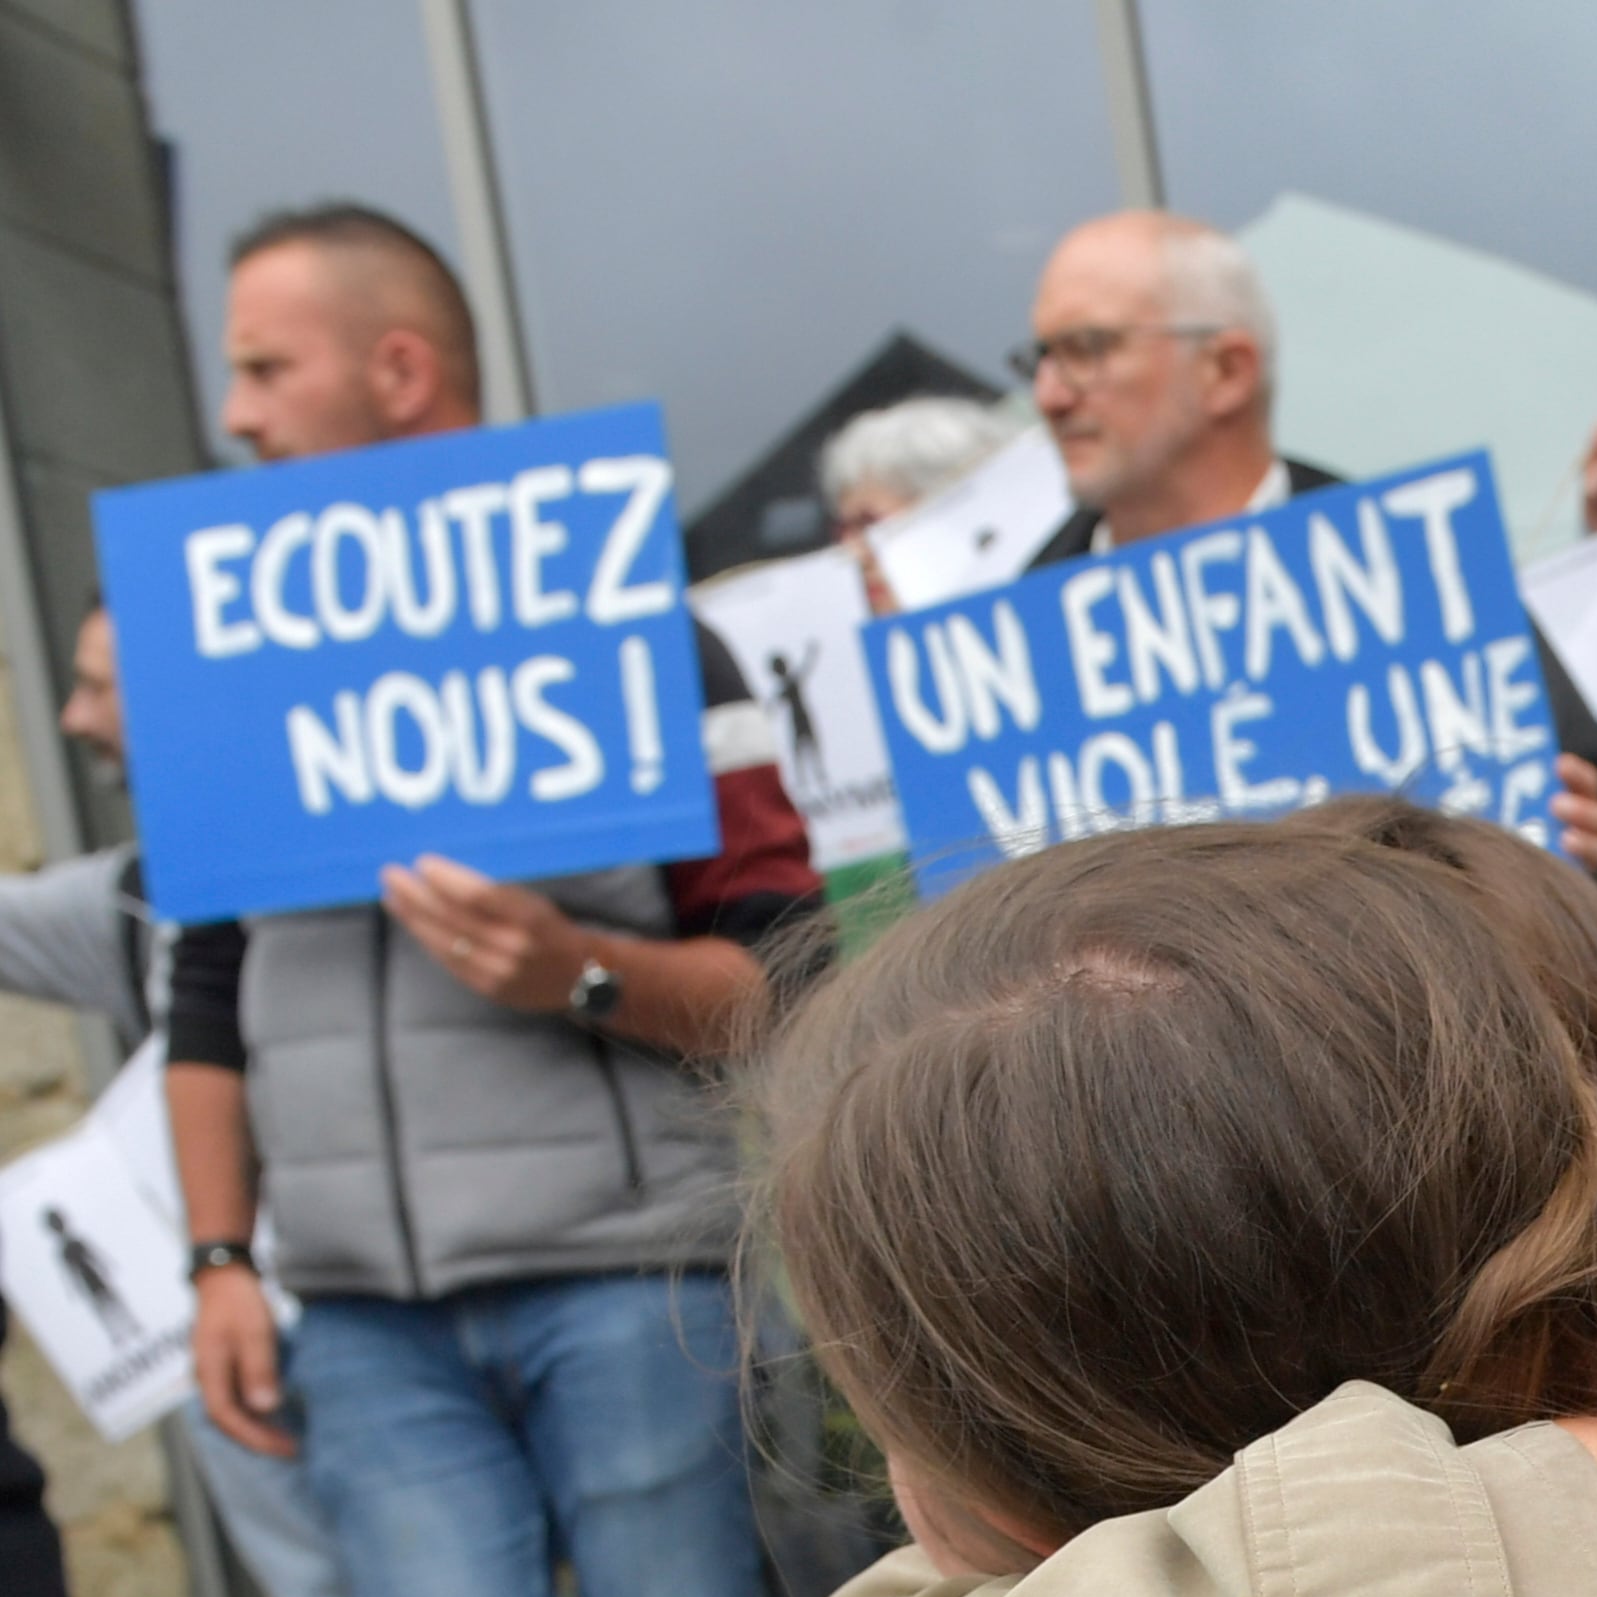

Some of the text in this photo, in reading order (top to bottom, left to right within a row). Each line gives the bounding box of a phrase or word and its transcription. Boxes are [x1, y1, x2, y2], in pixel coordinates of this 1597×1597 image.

[185, 453, 676, 659] ECOUTEZ
[885, 466, 1478, 755] UN ENFANT
[285, 635, 666, 816] NOUS !
[1346, 634, 1549, 786] UNE
